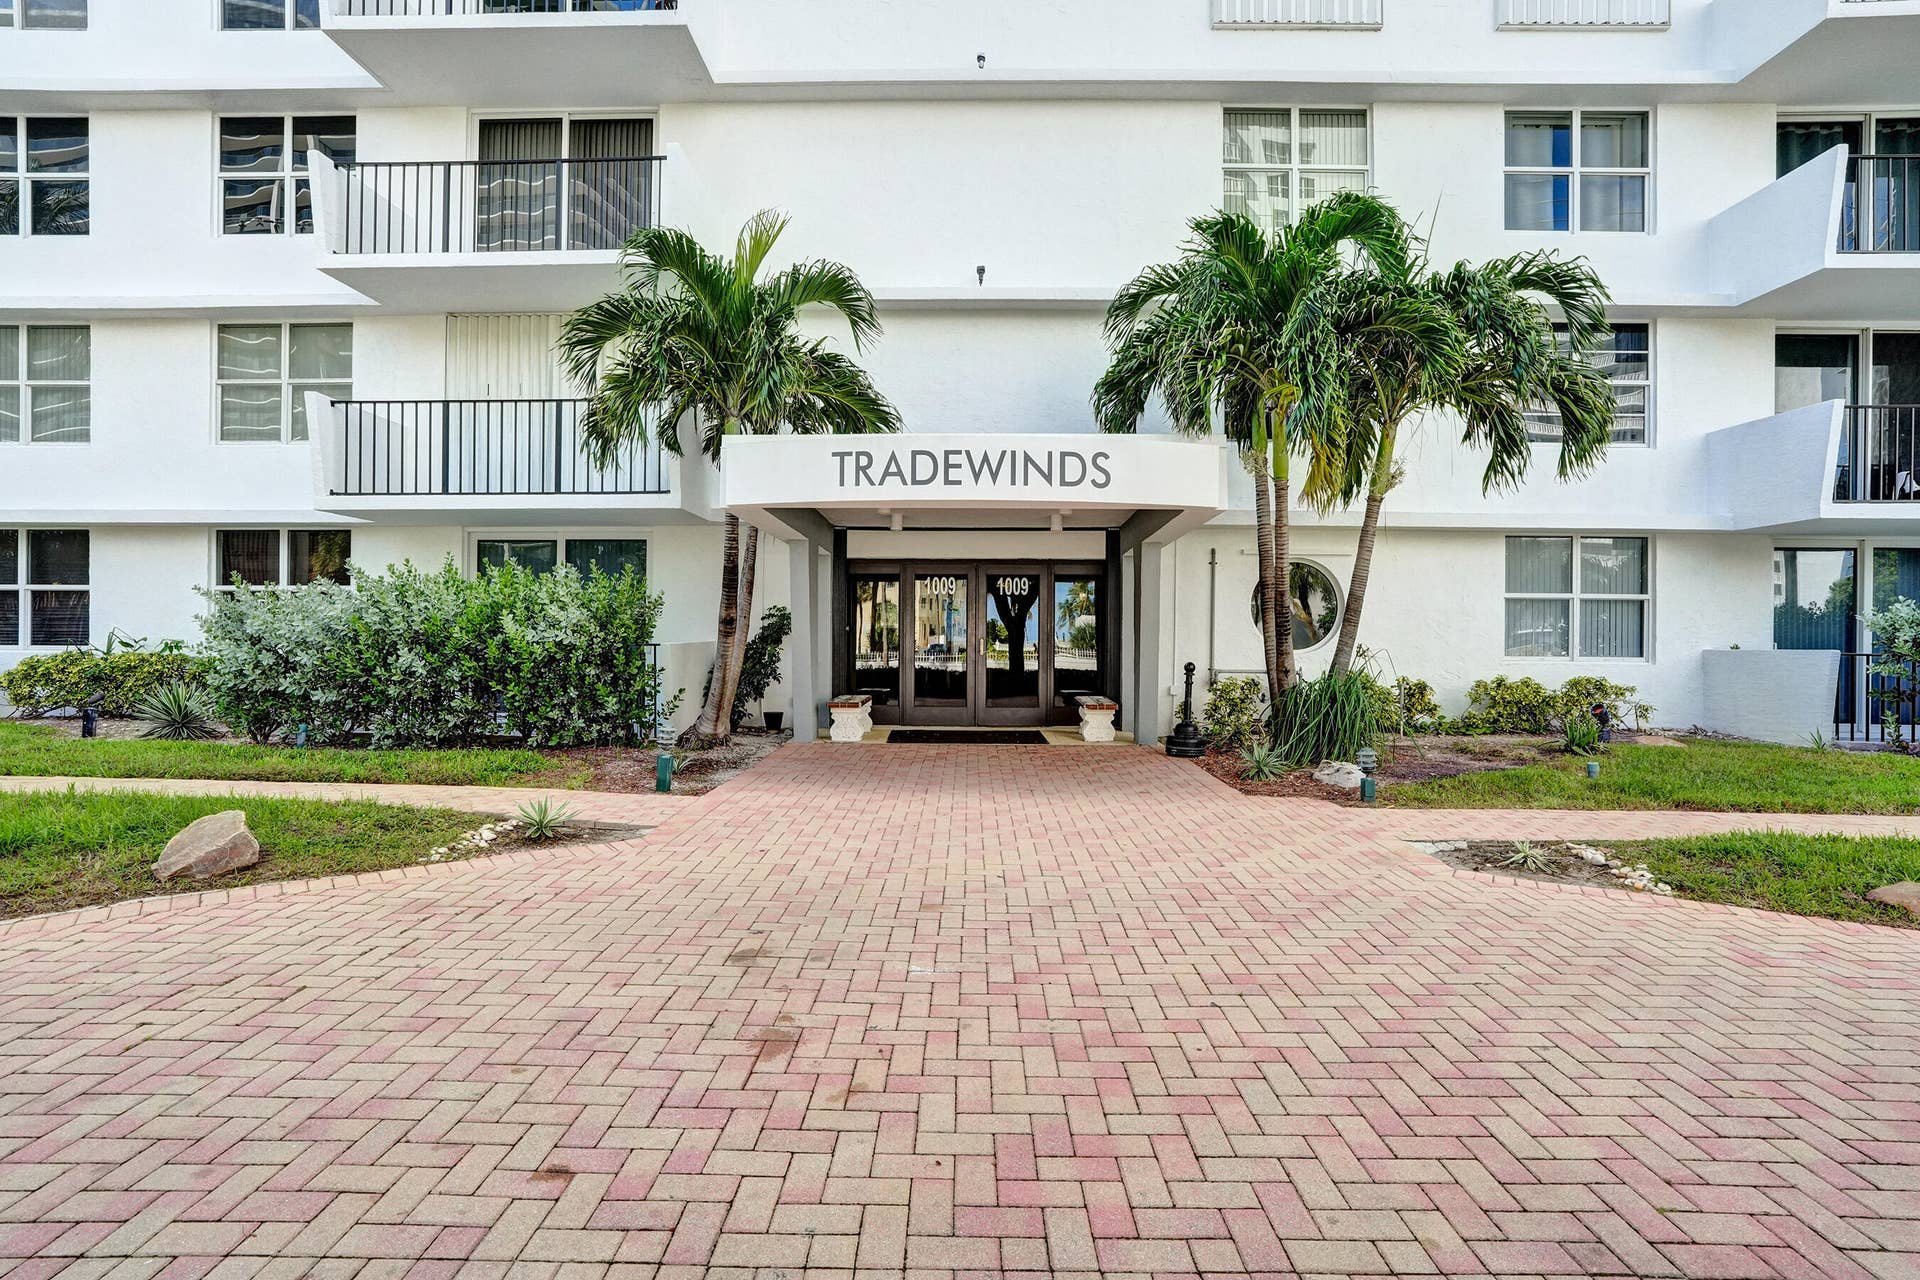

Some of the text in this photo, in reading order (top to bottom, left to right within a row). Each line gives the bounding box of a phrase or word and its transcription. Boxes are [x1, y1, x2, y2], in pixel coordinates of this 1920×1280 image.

[831, 449, 1112, 489] TRADEWINDS
[924, 576, 956, 595] 1009
[997, 577, 1029, 596] 1009
